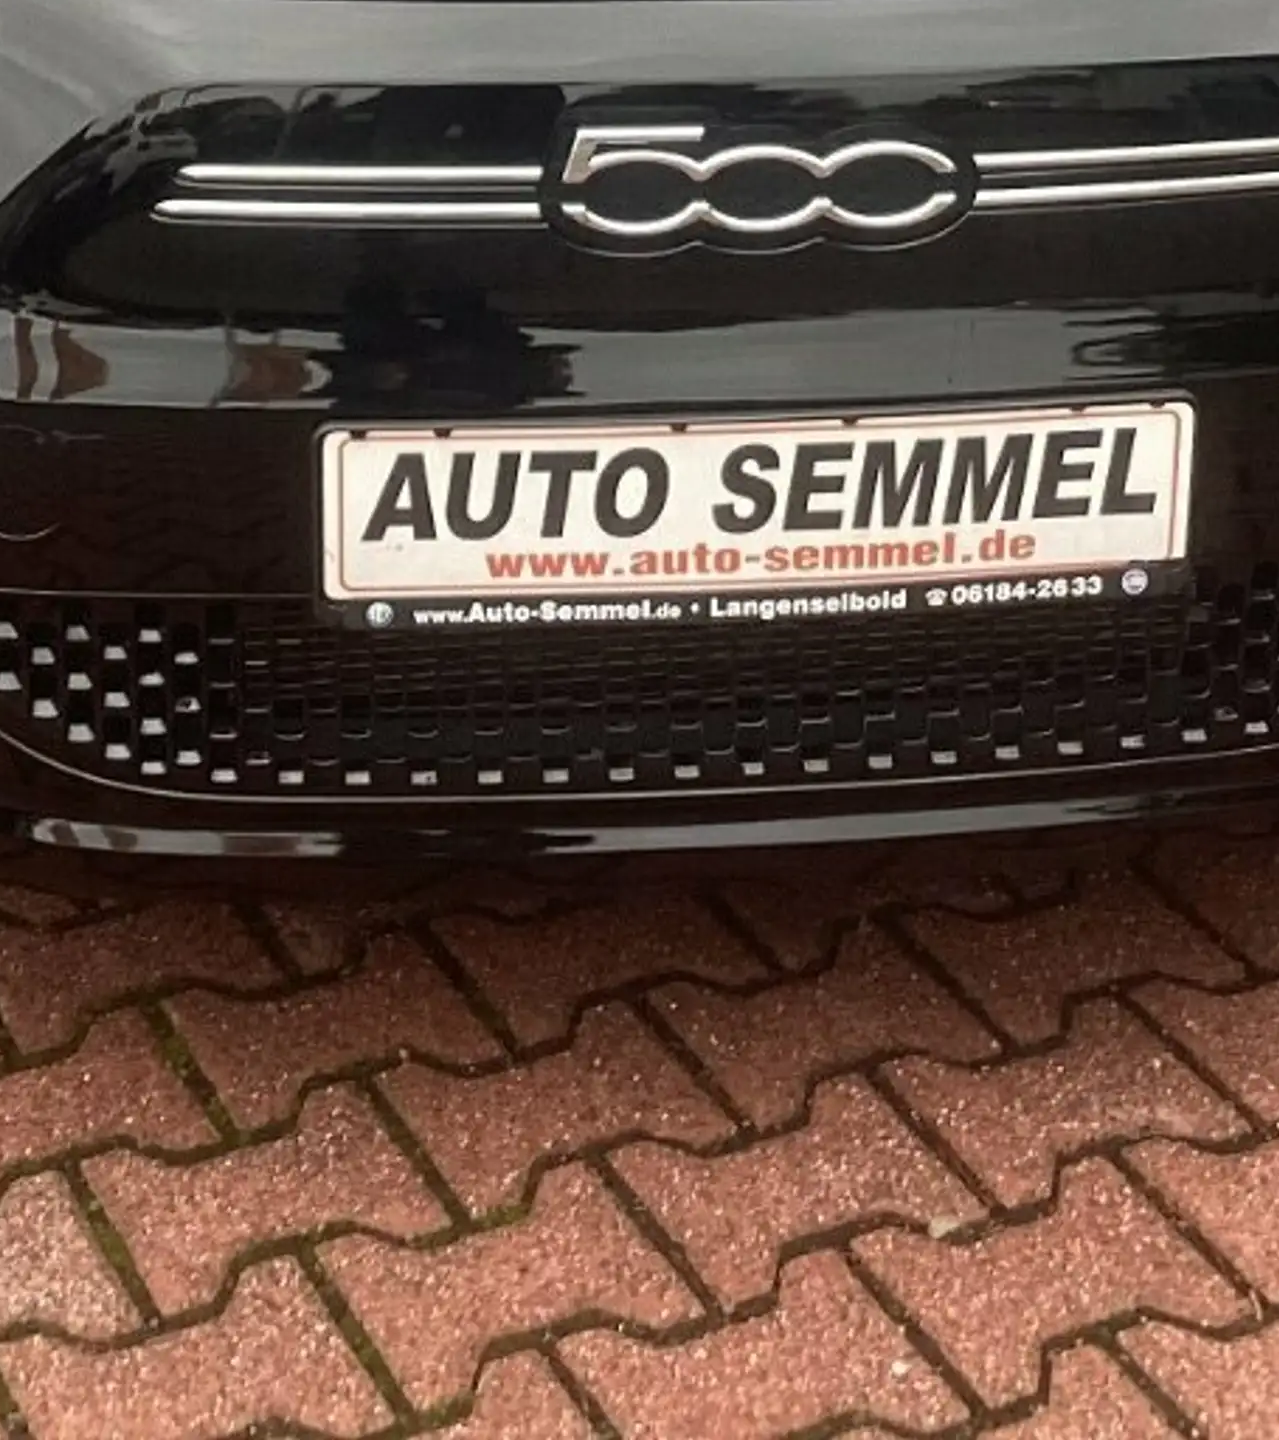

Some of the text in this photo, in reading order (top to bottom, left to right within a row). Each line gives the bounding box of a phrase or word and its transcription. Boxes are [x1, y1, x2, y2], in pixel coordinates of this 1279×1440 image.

[562, 126, 957, 235] 500
[361, 426, 1159, 543] AUTO SEMMEL
[486, 528, 1036, 579] www.auto-semmel.de
[413, 599, 682, 625] www.Auto-Semmel.de
[709, 589, 908, 621] Langenselbold
